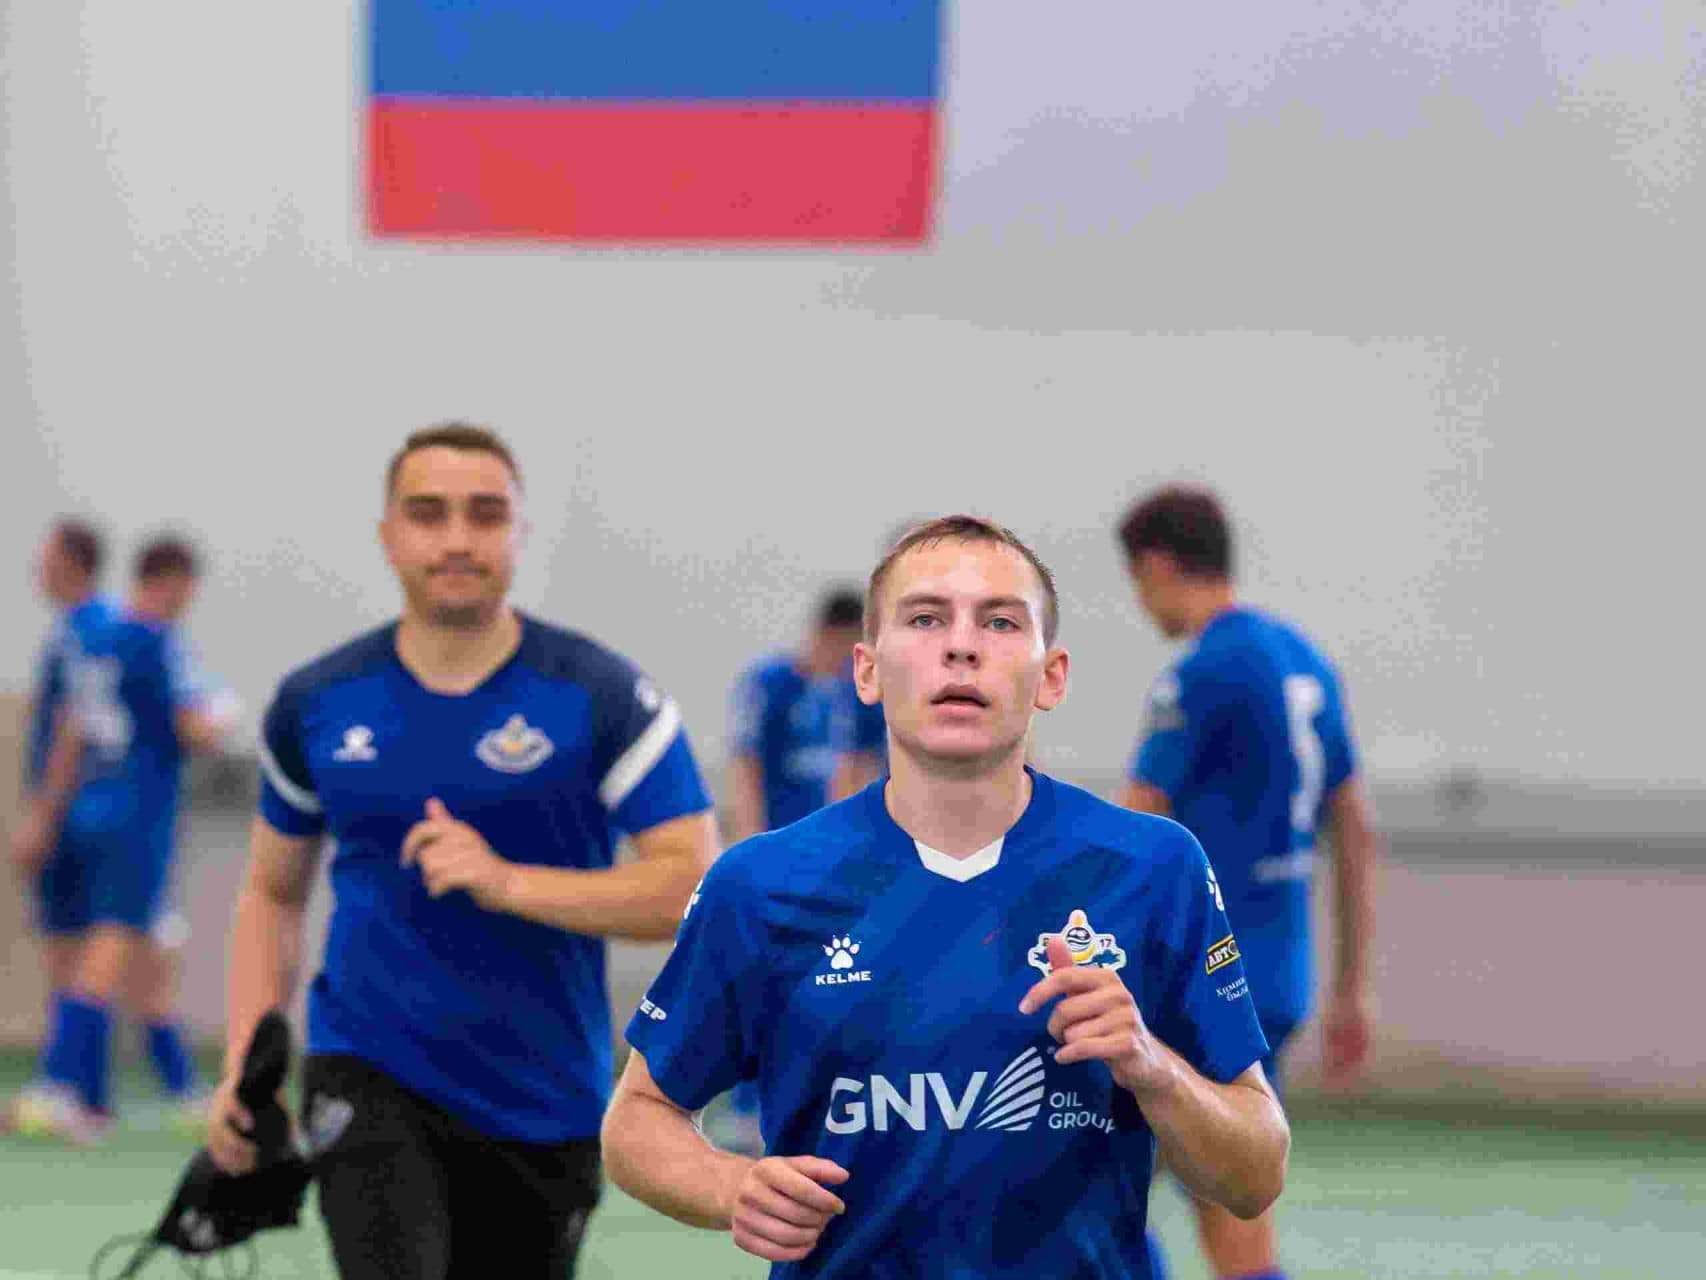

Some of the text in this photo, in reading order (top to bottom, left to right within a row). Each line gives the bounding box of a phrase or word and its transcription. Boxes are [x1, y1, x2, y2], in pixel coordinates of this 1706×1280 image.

[815, 970, 872, 986] KELME
[825, 1071, 988, 1134] GNV
[1049, 1091, 1083, 1108] OIL
